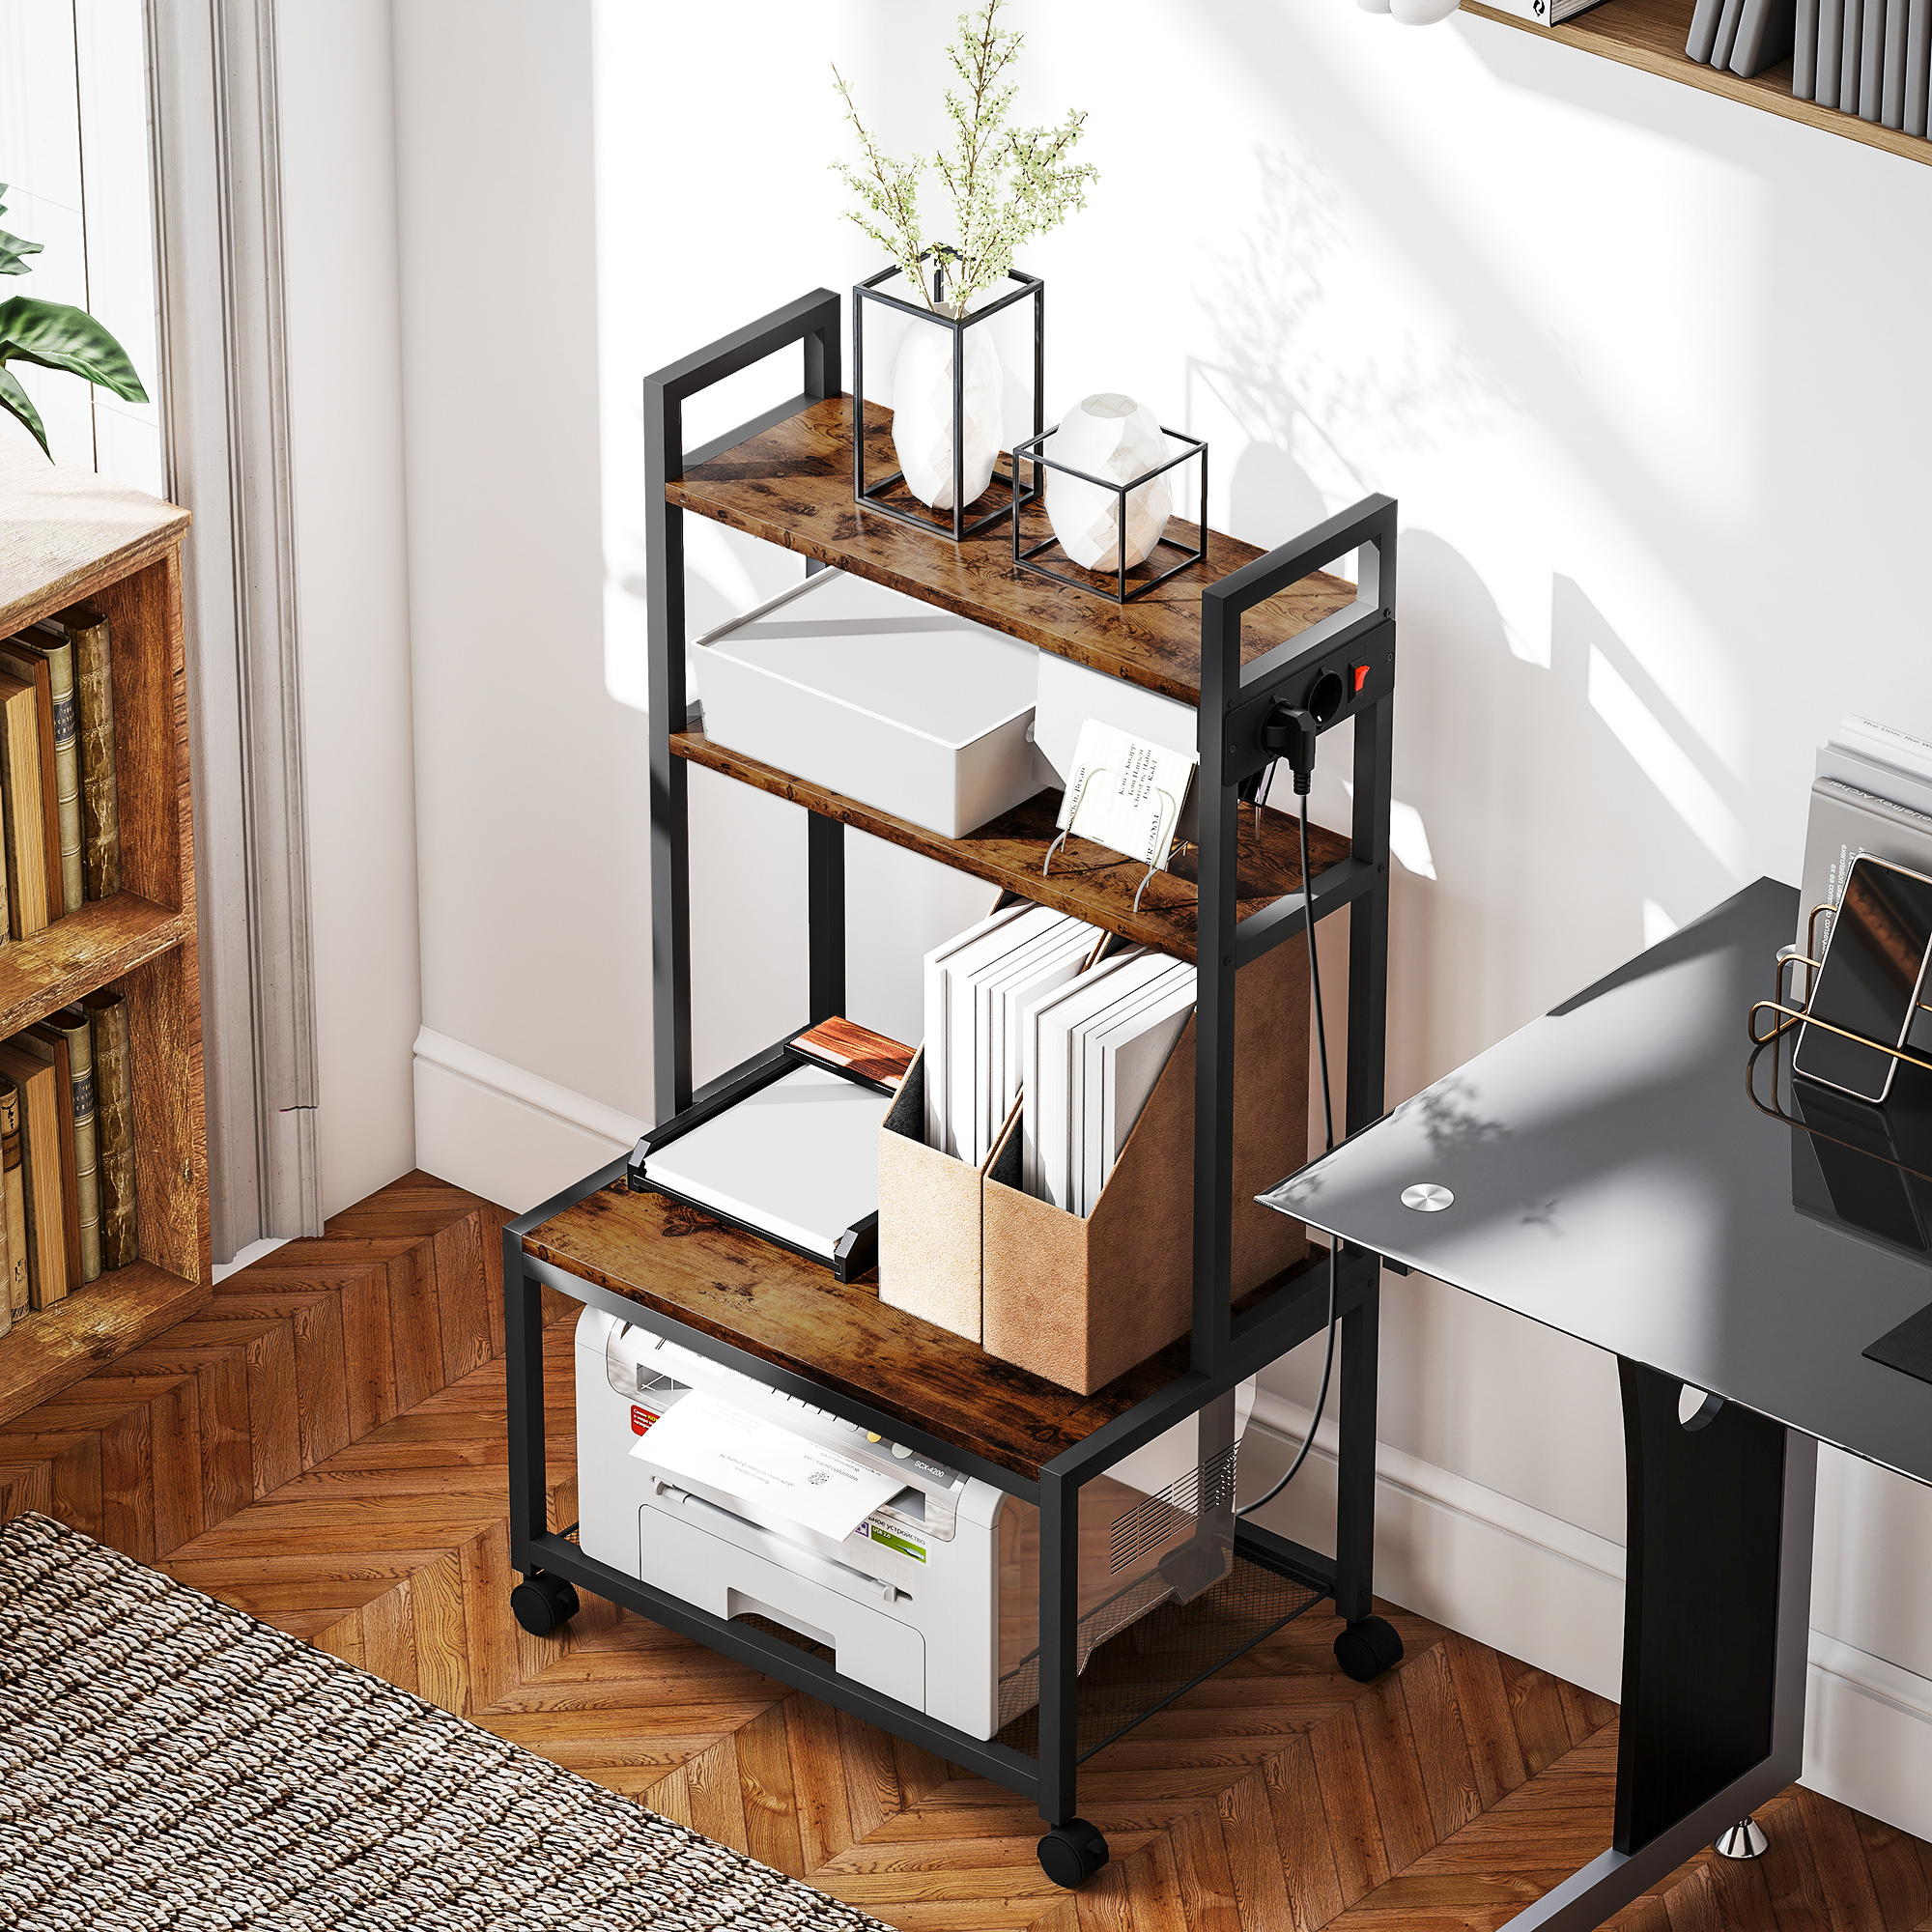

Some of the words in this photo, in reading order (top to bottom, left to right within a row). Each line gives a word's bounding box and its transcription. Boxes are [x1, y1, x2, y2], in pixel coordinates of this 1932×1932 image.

[1133, 774, 1147, 808] Christne
[1828, 781, 1875, 800] Archer
[914, 1460, 945, 1478] SCX-4200
[886, 1523, 926, 1546] устройство
